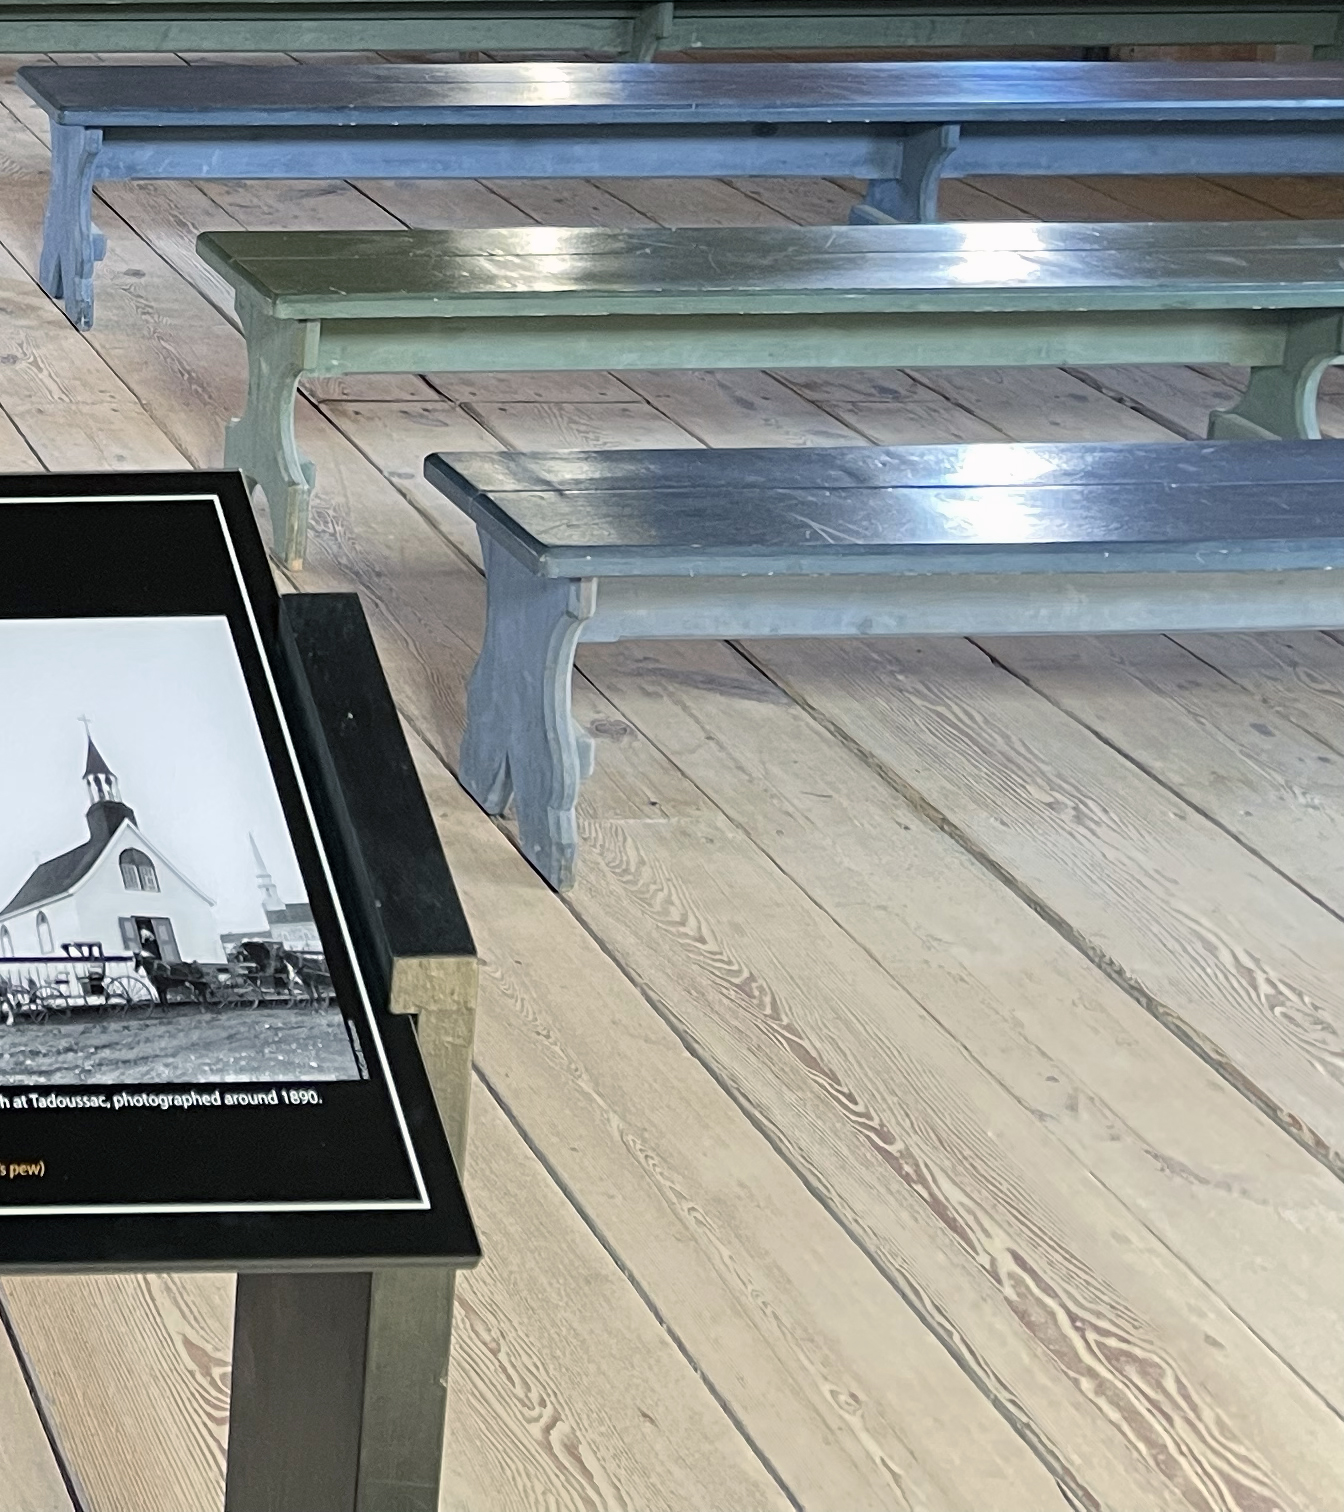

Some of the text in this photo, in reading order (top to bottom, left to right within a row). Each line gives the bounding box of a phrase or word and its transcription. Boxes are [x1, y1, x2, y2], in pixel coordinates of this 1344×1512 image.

[12, 1095, 29, 1108] at
[28, 1093, 111, 1109] Tadoussac,
[112, 1090, 222, 1111] photographed
[224, 1090, 279, 1105] around
[281, 1090, 323, 1104] 1890.
[9, 1161, 45, 1179] pew)
